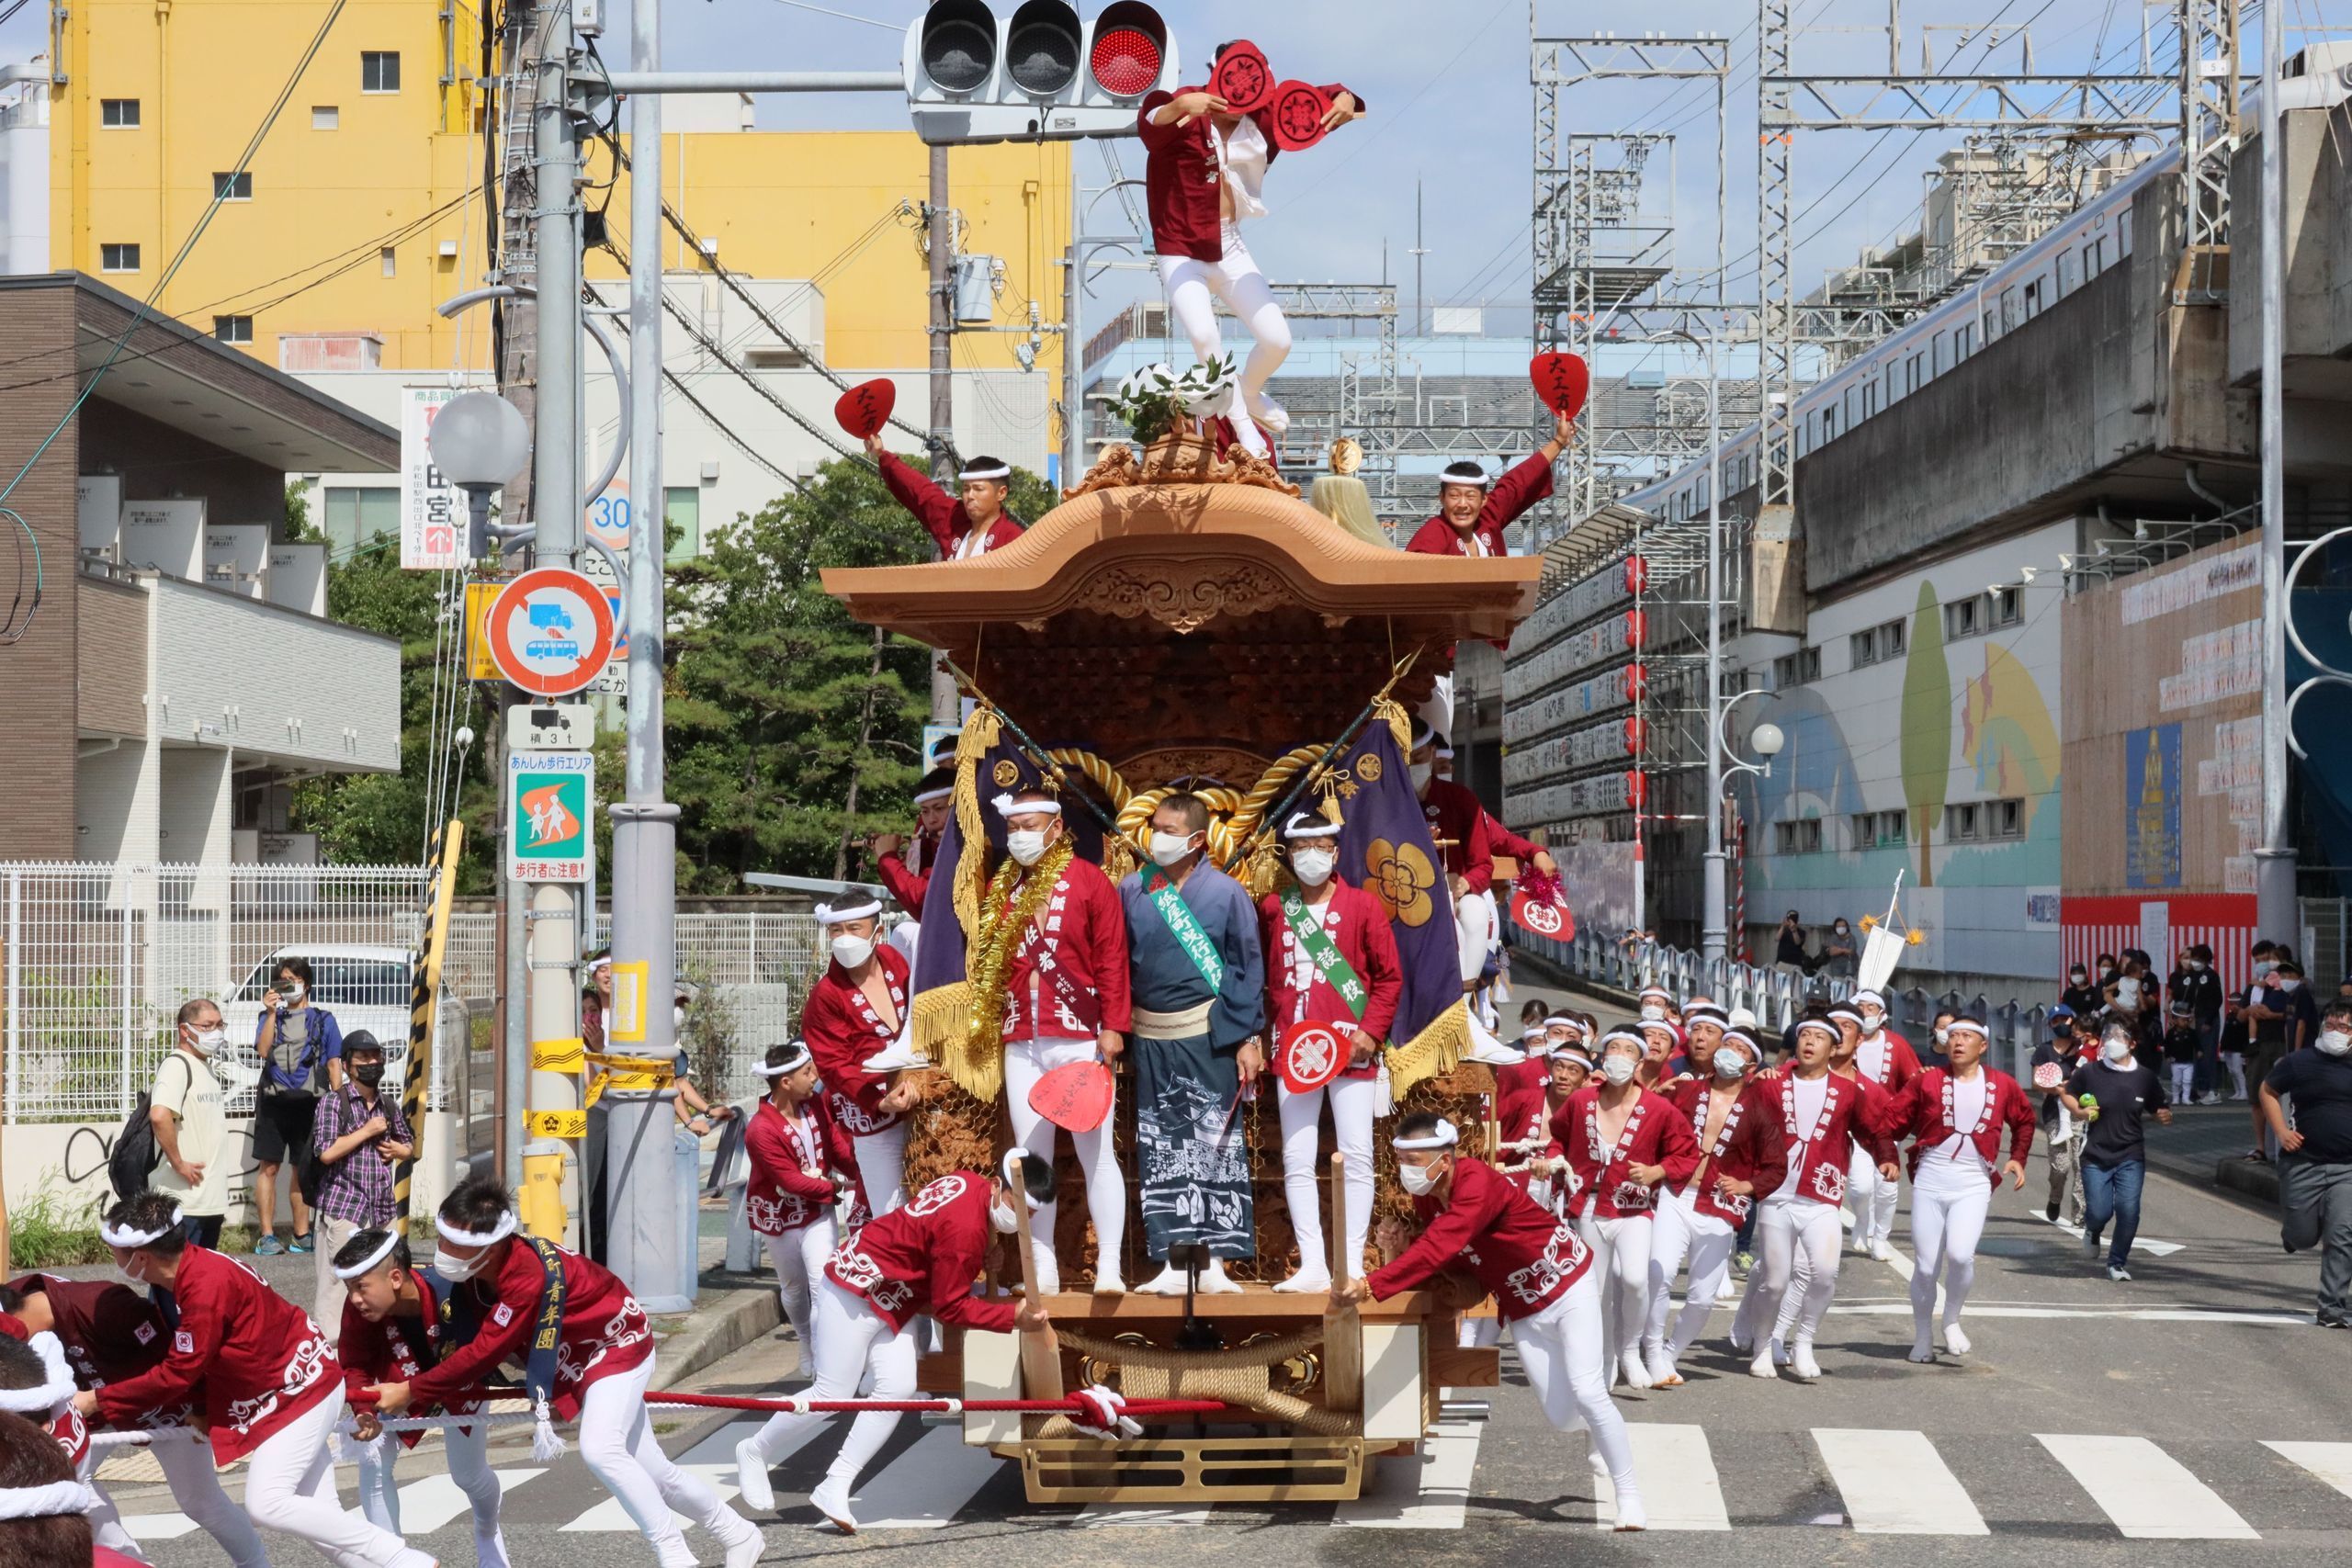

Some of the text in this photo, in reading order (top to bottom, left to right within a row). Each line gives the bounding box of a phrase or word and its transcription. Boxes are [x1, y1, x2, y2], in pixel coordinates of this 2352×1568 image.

[1549, 356, 1570, 411] 大工方
[856, 387, 878, 434] 大工方
[594, 497, 631, 528] 30
[511, 755, 593, 771] あんしん歩行エリア
[1295, 917, 1364, 1002] 相談役
